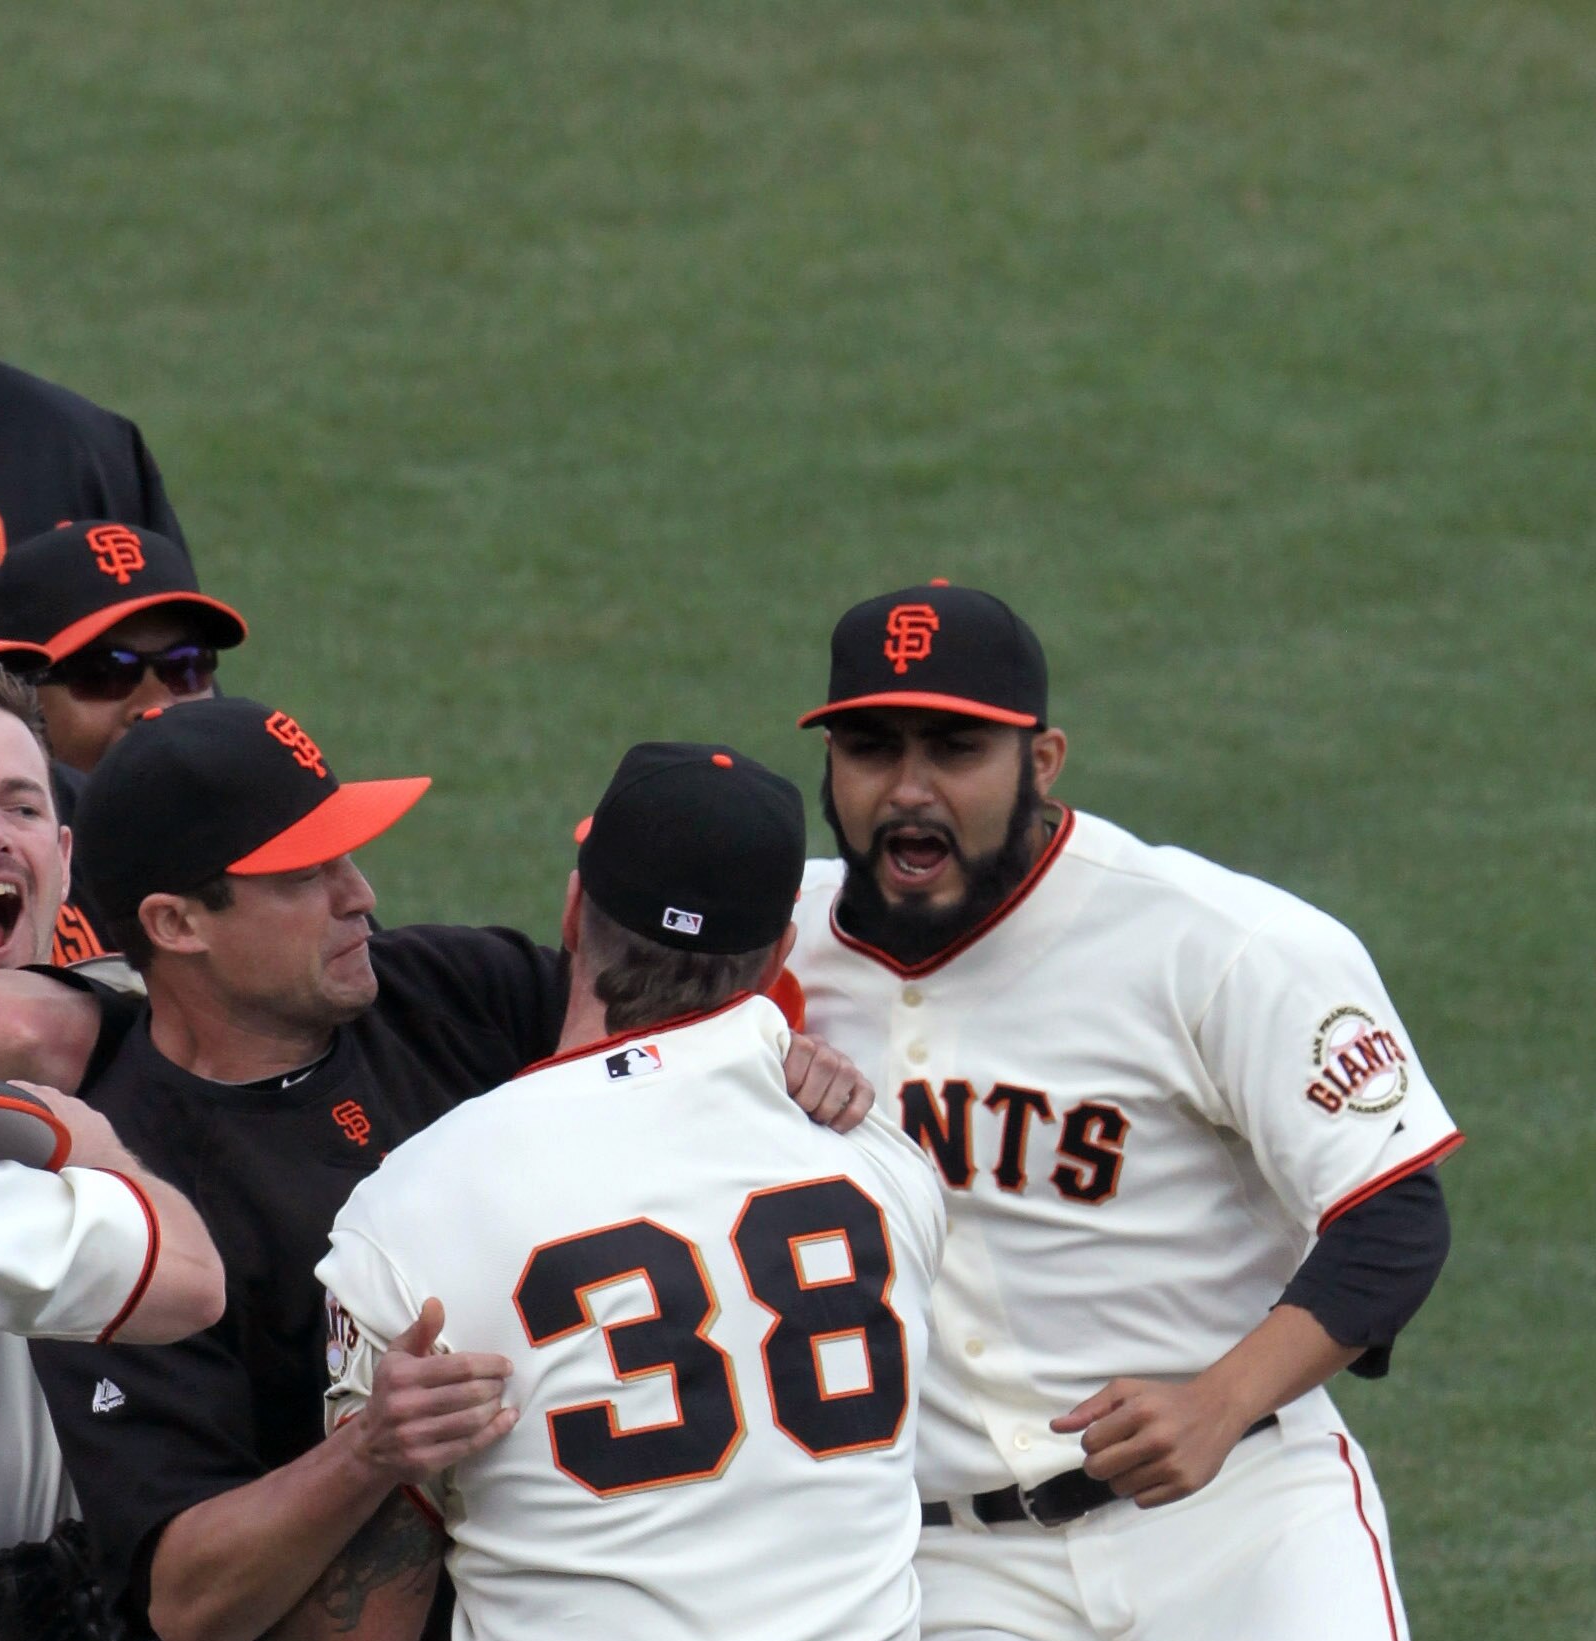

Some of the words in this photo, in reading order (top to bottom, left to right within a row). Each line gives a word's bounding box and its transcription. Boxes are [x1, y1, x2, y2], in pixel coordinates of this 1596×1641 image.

[85, 523, 146, 585] SF
[884, 603, 940, 675] SF
[264, 709, 327, 779] SF
[331, 1100, 371, 1146] SF
[512, 1172, 911, 1499] 38
